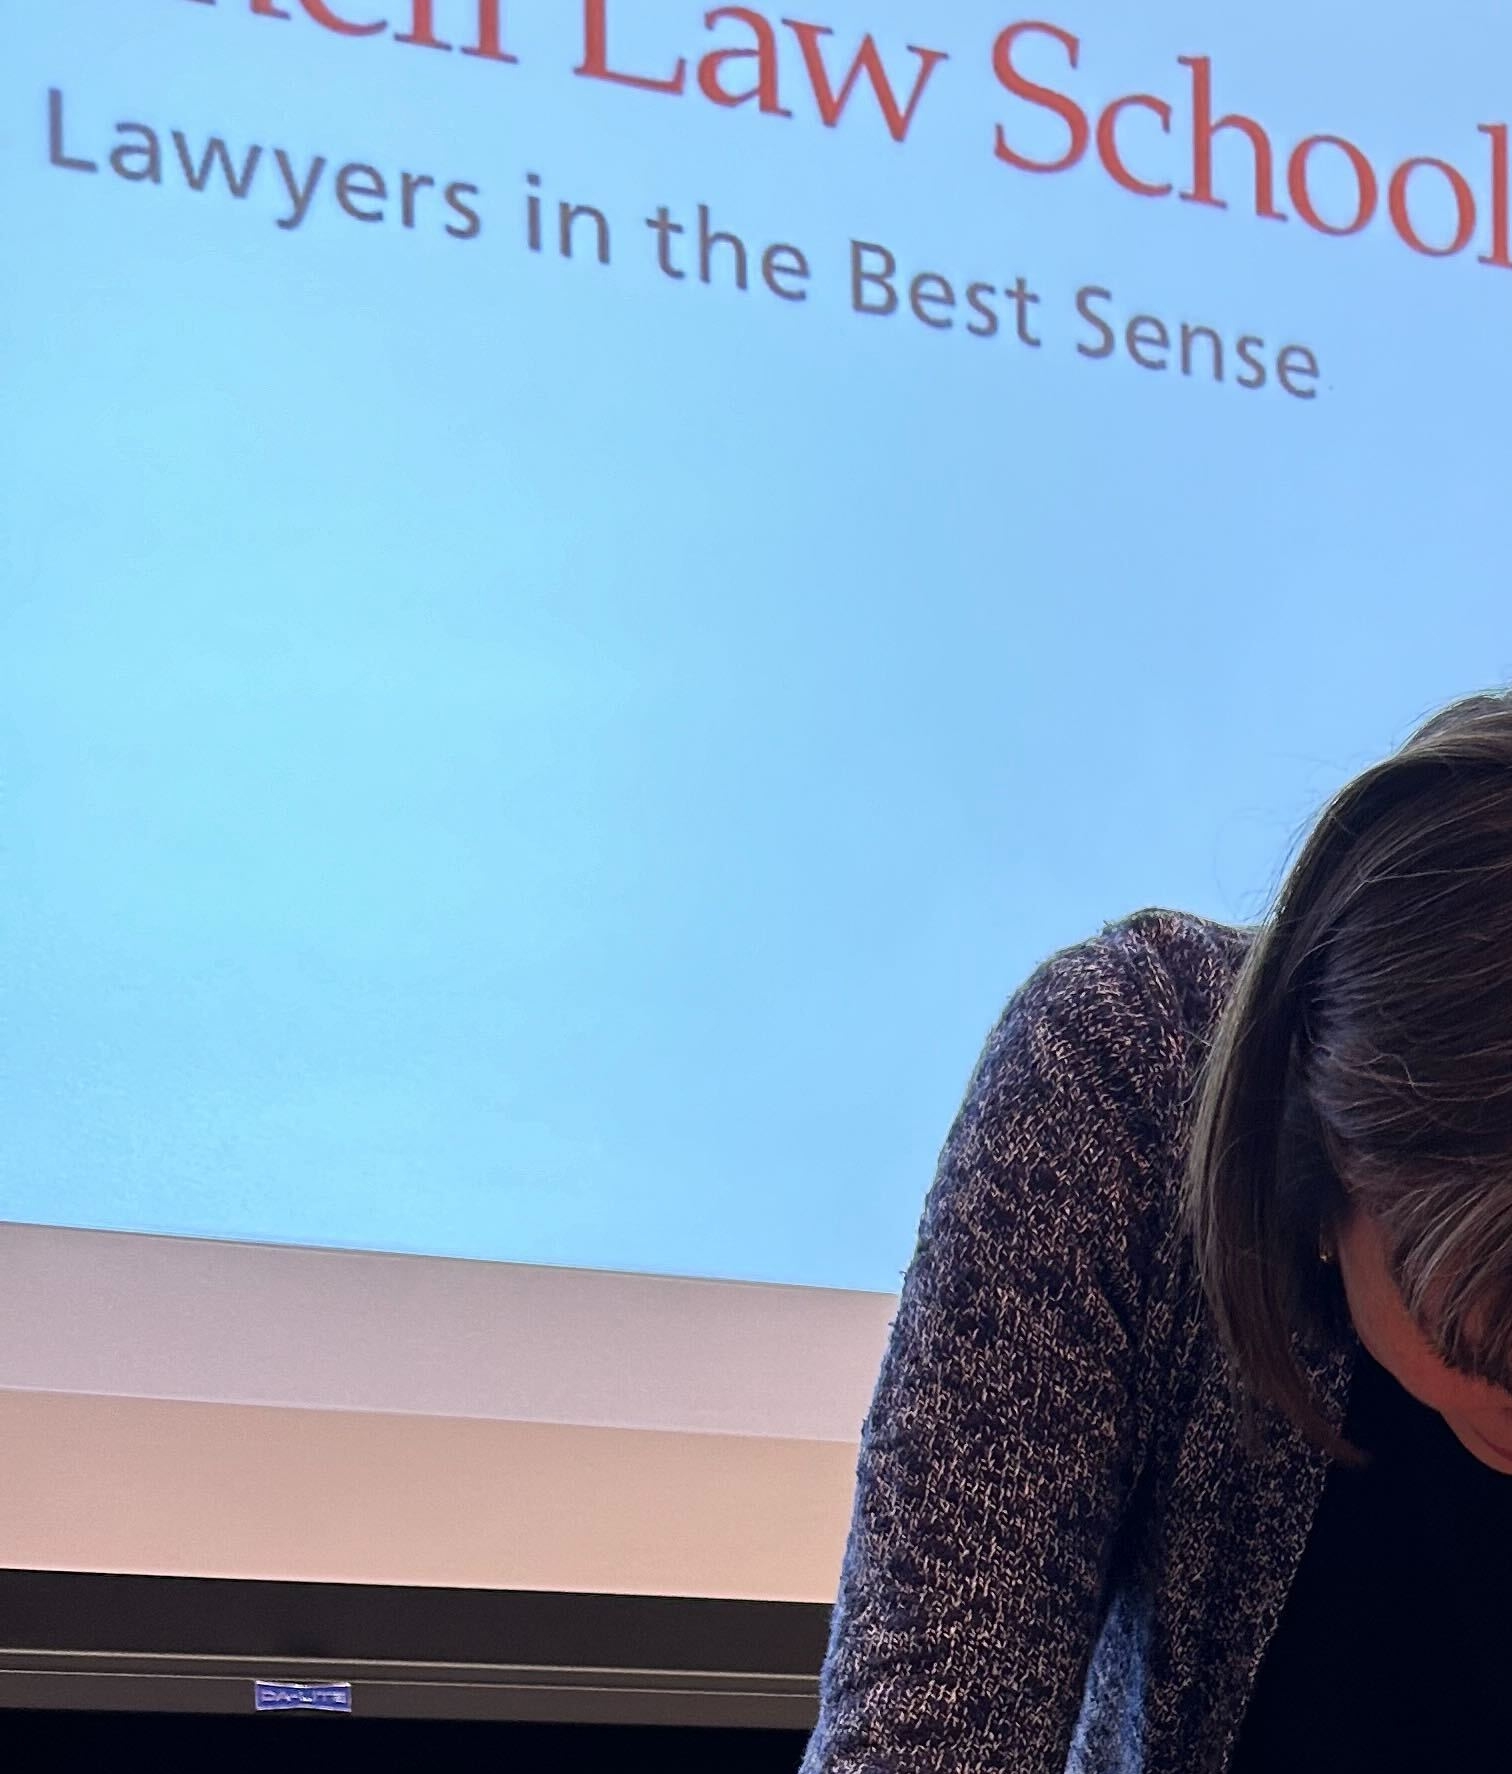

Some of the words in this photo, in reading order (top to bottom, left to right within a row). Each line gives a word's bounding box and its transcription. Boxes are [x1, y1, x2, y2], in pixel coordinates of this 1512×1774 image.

[574, 0, 948, 145] Law
[47, 88, 481, 240] Lawyers
[524, 173, 612, 265] in
[645, 205, 811, 302] the
[849, 240, 1042, 349] Best
[1075, 285, 1320, 399] Sense
